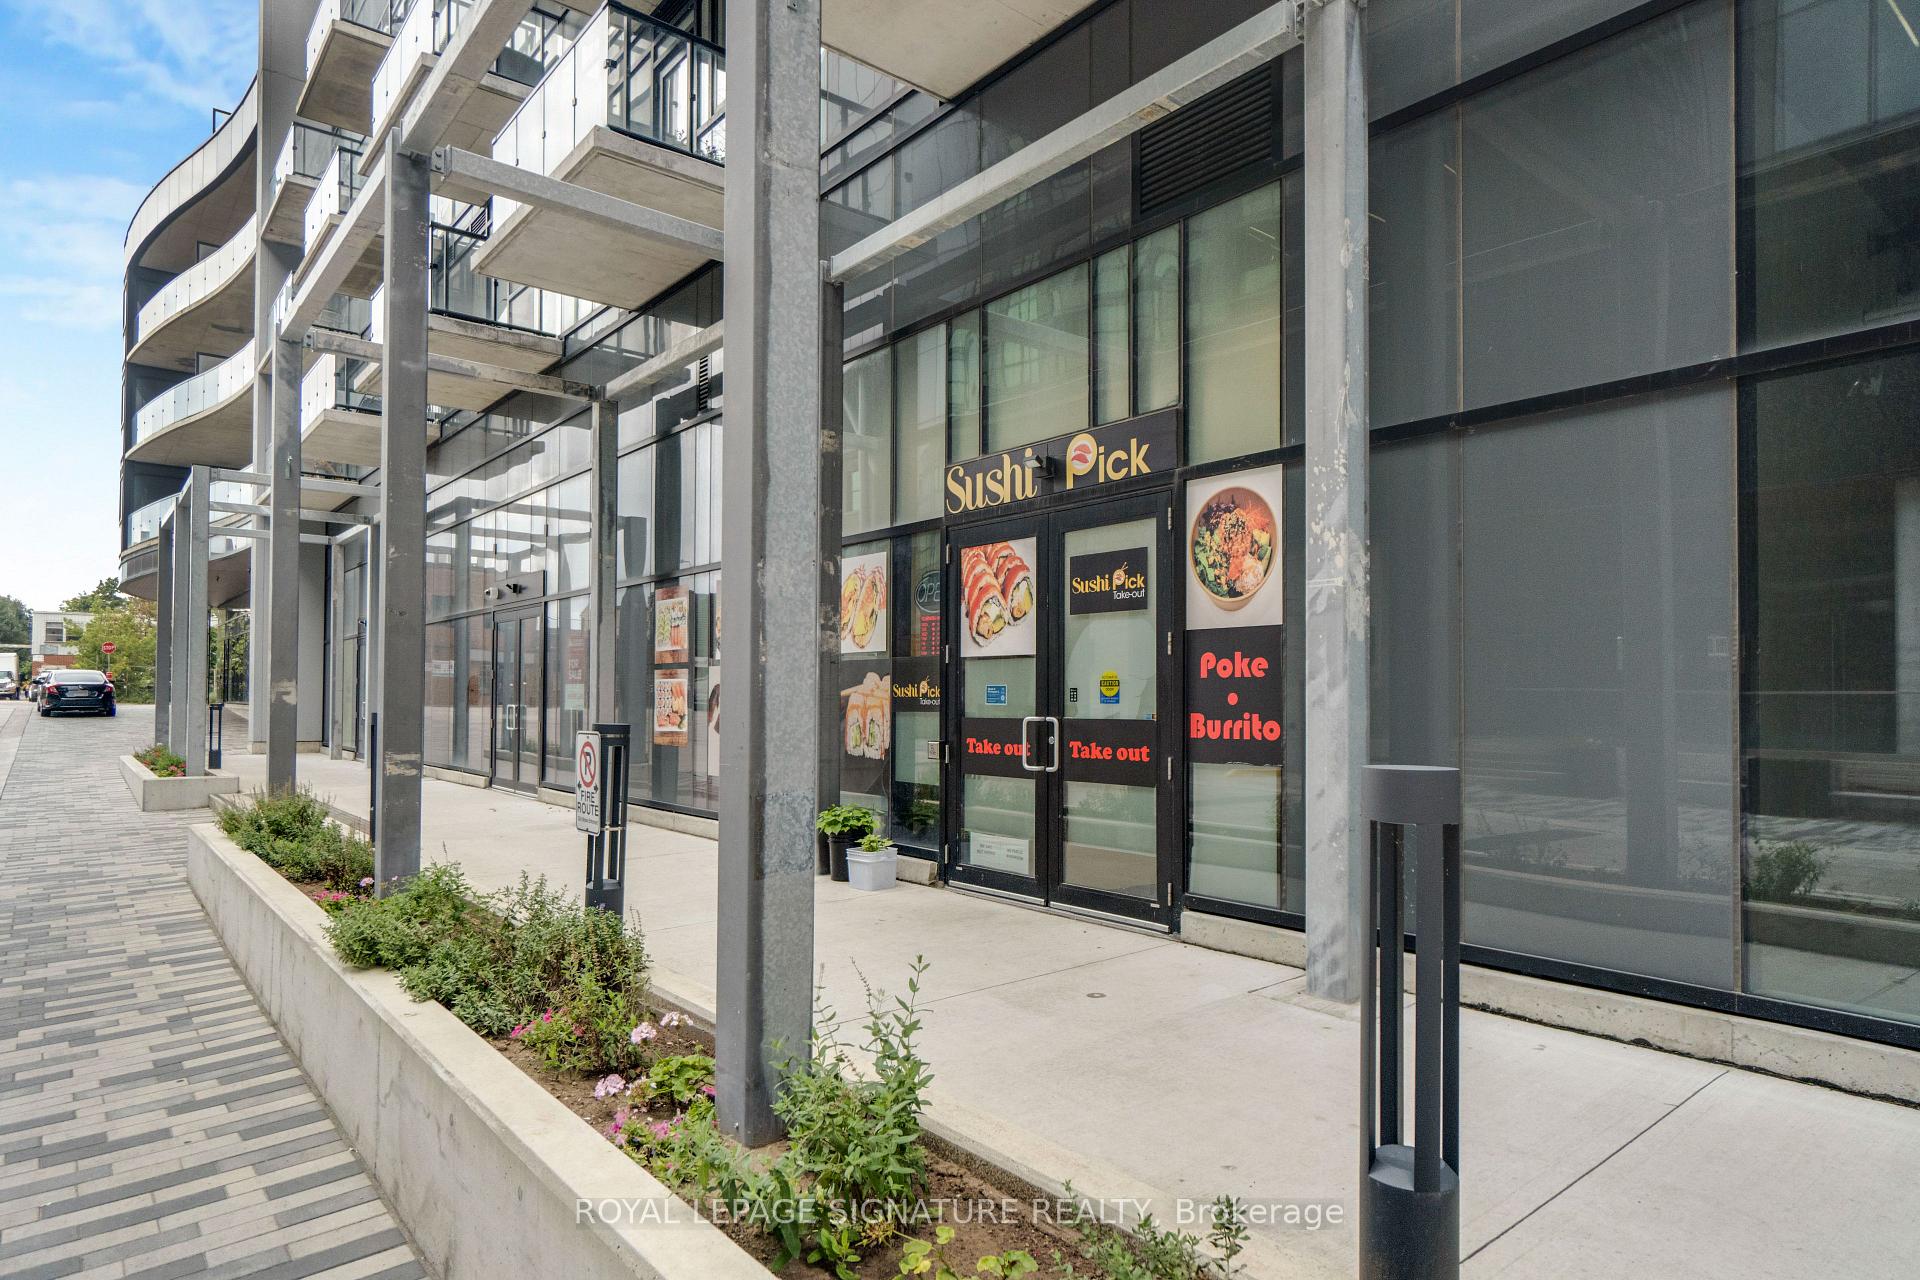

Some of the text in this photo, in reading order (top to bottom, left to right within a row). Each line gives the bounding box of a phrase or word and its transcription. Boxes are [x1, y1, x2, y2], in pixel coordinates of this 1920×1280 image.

[946, 433, 1152, 514] Sushi Pick
[1072, 568, 1145, 594] Sushi Pick
[1113, 588, 1145, 600] Take-out
[1200, 651, 1269, 679] Poke
[892, 680, 940, 698] Sushi Pick
[1190, 712, 1281, 741] Burrito
[966, 737, 1000, 756] Take
[1069, 741, 1150, 763] Take out
[580, 790, 595, 804] FIRE
[577, 801, 599, 817] ROUTE
